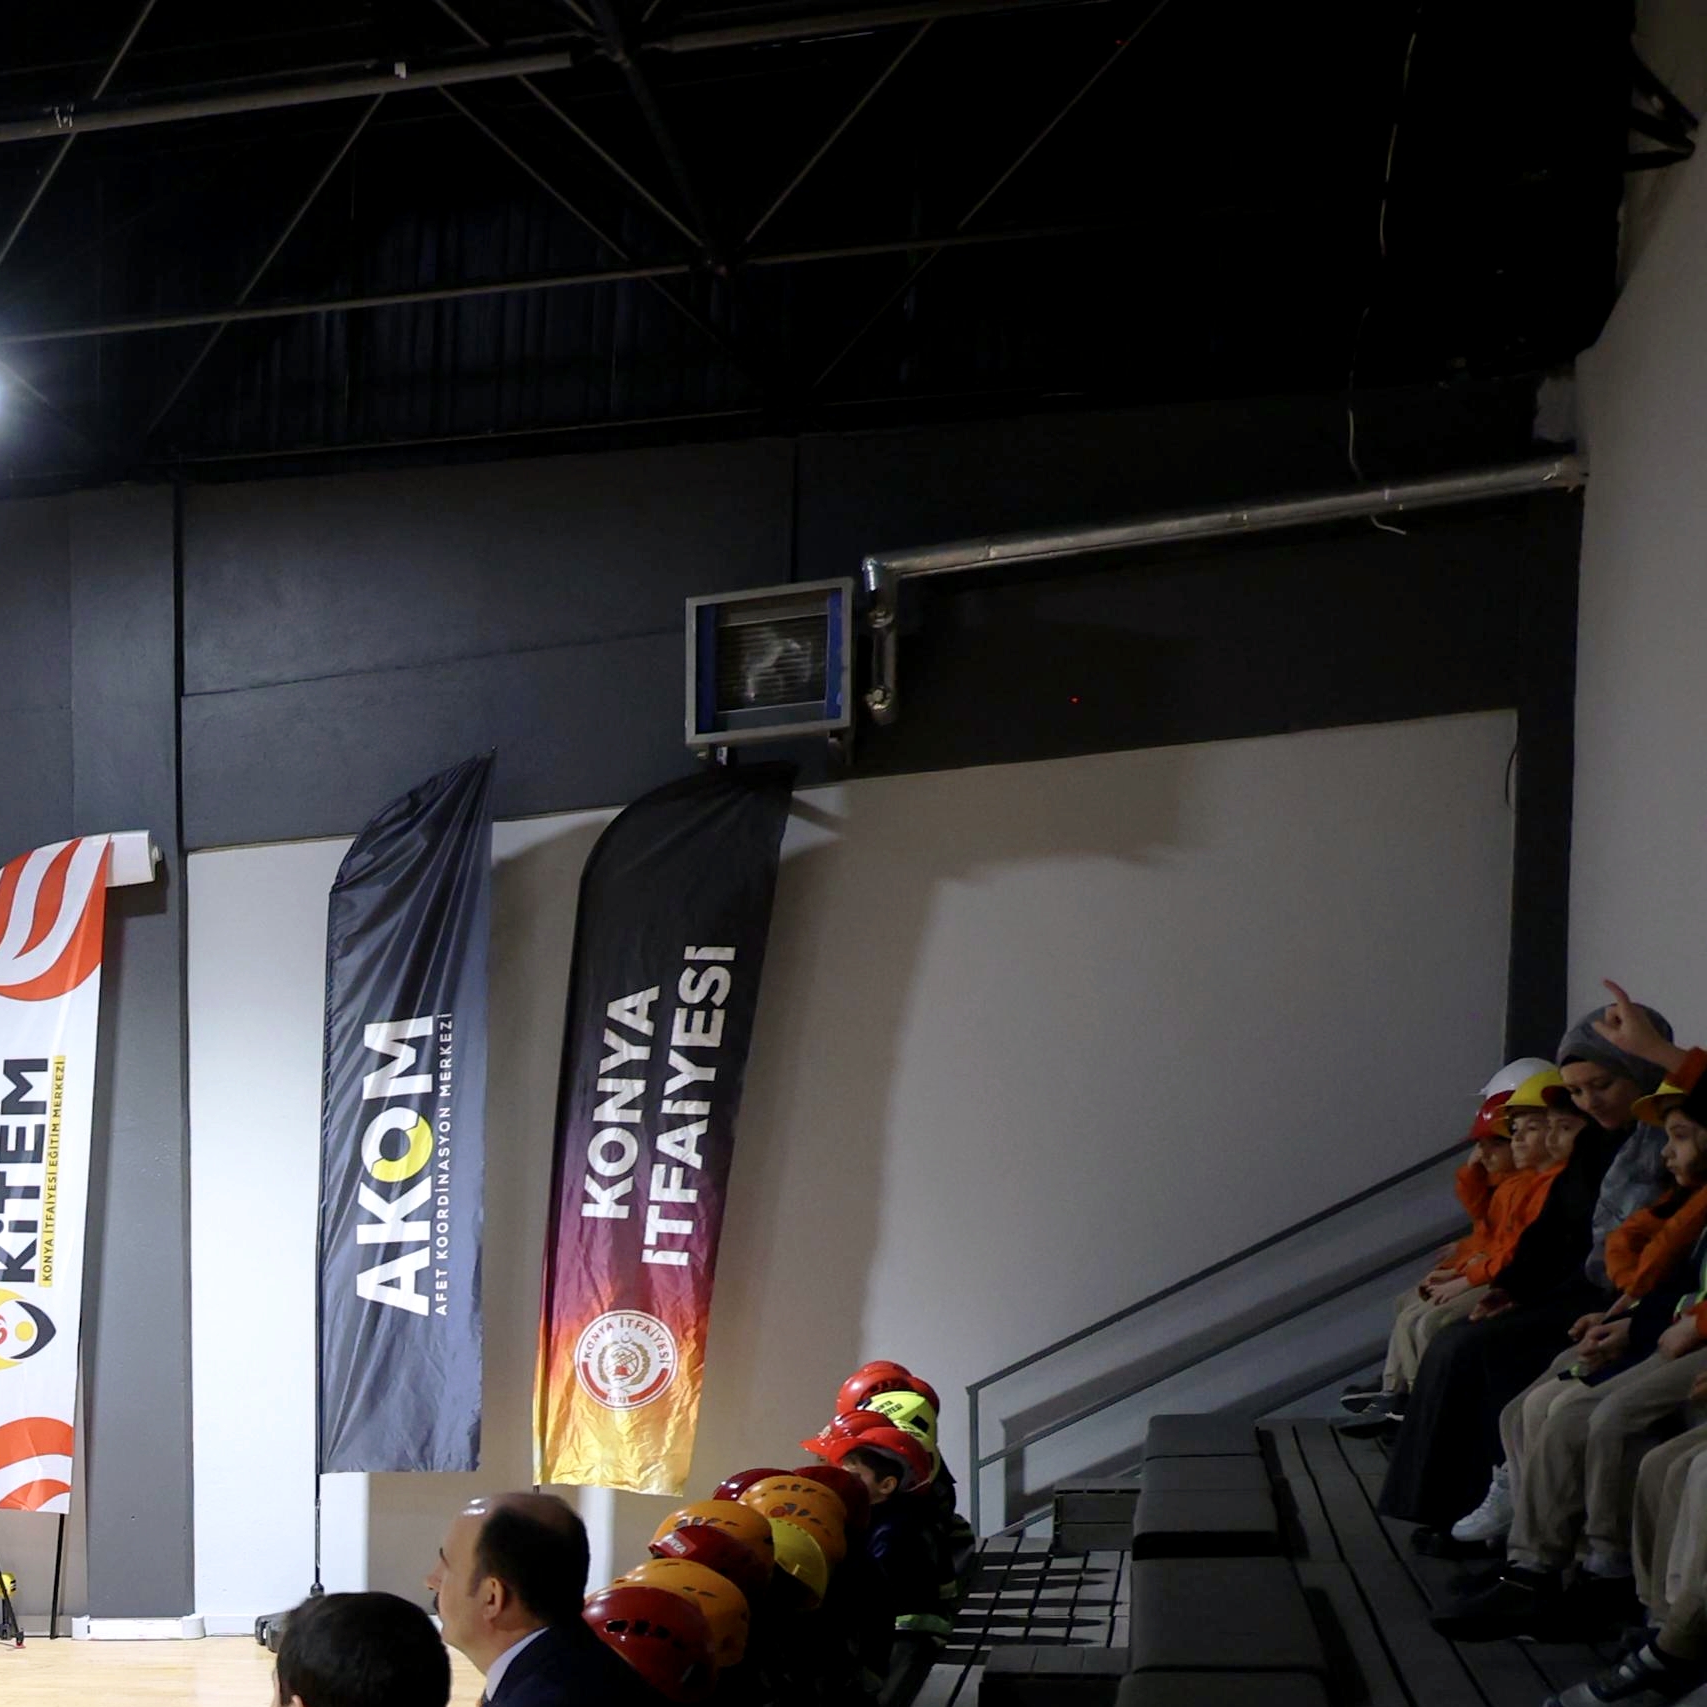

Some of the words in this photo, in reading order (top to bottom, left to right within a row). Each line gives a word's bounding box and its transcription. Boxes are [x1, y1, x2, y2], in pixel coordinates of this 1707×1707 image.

[437, 1012, 453, 1097] MERKEZİ
[53, 1060, 65, 1119] MERKEZİ
[581, 985, 661, 1220] KONYA
[641, 945, 737, 1267] İTFAİYESİ
[48, 1122, 60, 1167] EĞİTİM
[356, 1015, 434, 1318] AKOM
[44, 1171, 57, 1235] İTFAİYESİ
[434, 1106, 451, 1260] KOORDİNASYON
[41, 1238, 54, 1283] KONYA
[434, 1268, 448, 1316] AFET
[583, 1321, 615, 1359] KONYA
